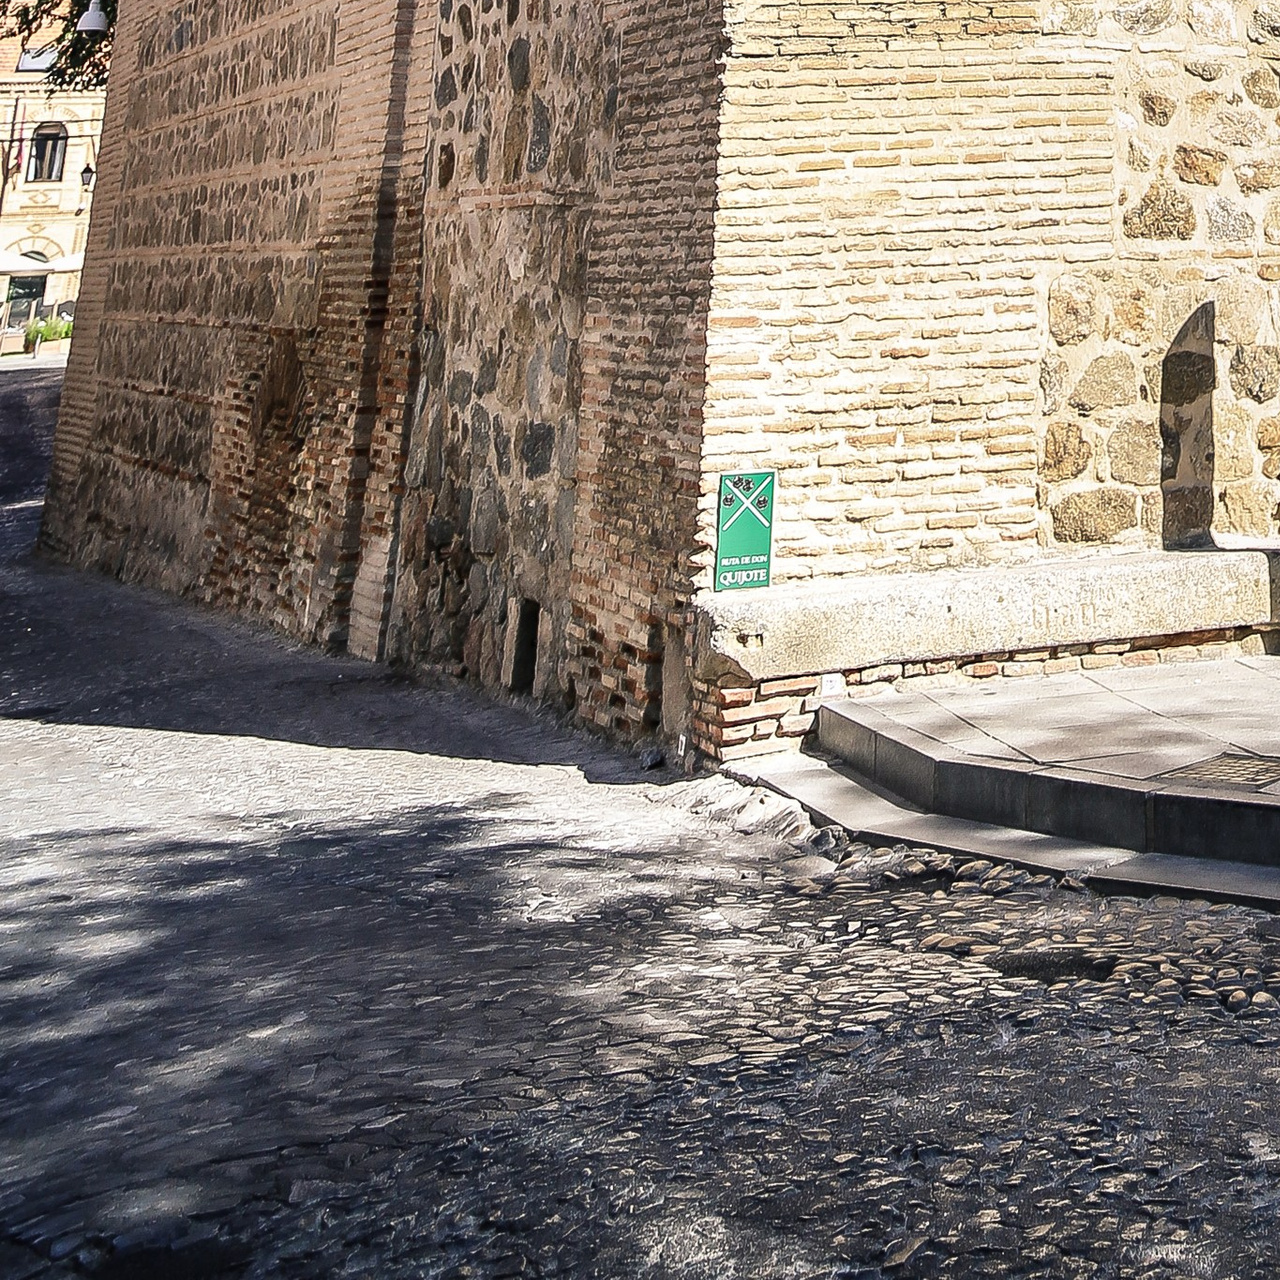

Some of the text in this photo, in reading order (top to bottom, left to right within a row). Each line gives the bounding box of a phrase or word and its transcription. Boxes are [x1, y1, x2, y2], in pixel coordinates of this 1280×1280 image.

[721, 555, 768, 566] RUTA DE DON
[719, 569, 767, 587] QUIJOTE
